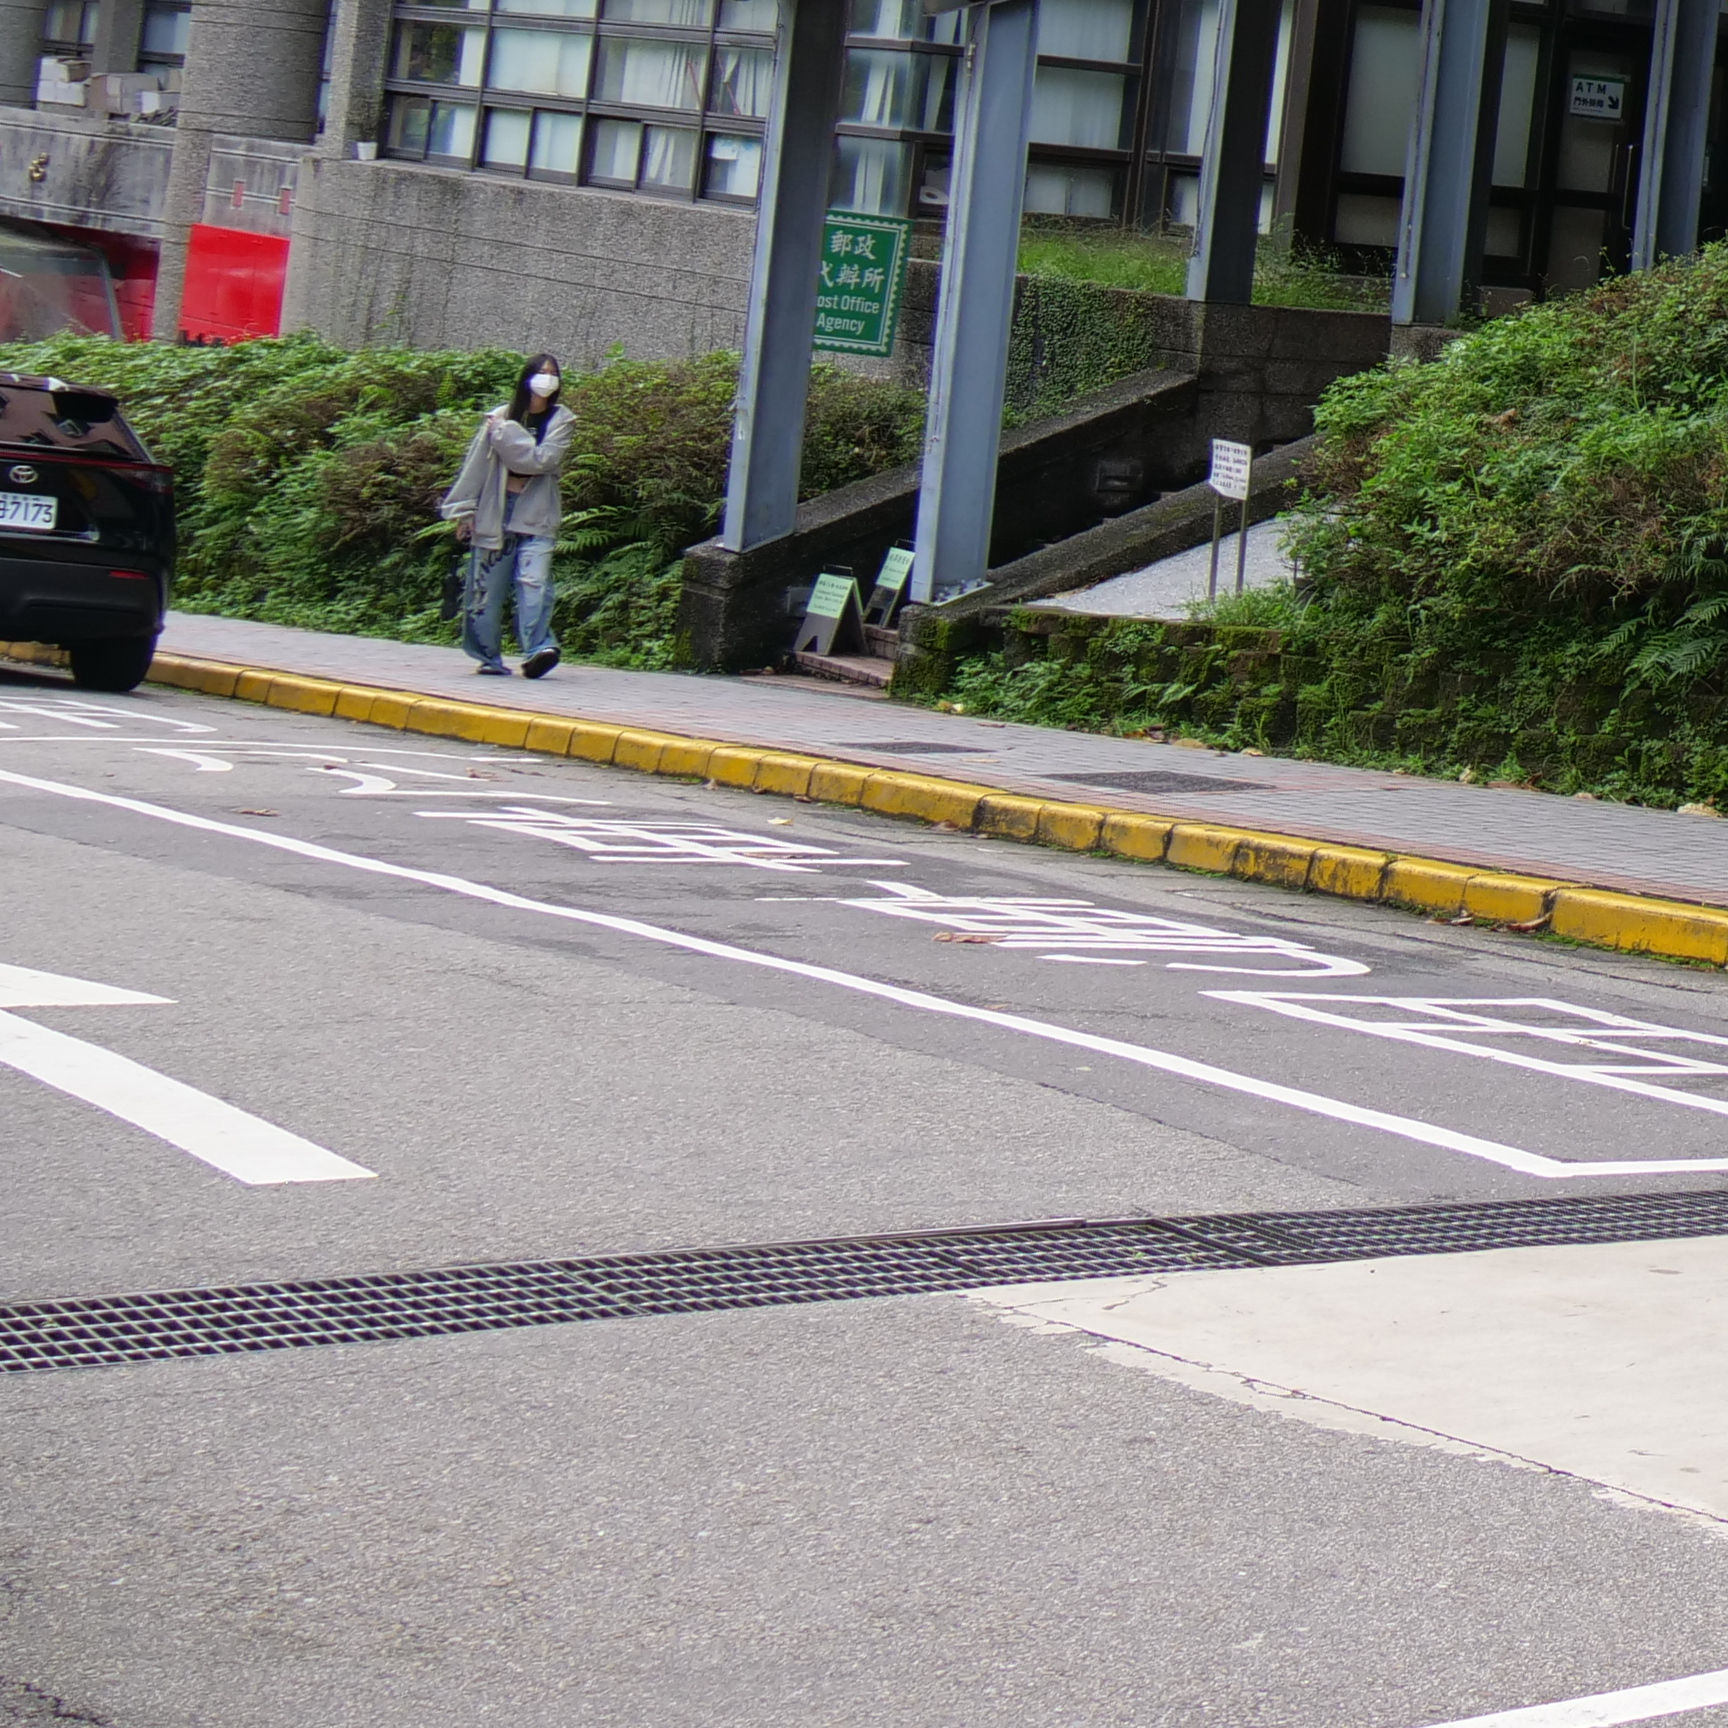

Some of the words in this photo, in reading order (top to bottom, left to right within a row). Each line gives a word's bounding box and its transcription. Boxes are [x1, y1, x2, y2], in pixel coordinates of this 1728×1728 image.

[1576, 81, 1607, 95] ATM
[830, 230, 876, 260] 郵政
[816, 294, 838, 310] ost
[840, 295, 880, 314] Office
[816, 312, 866, 336] Agency
